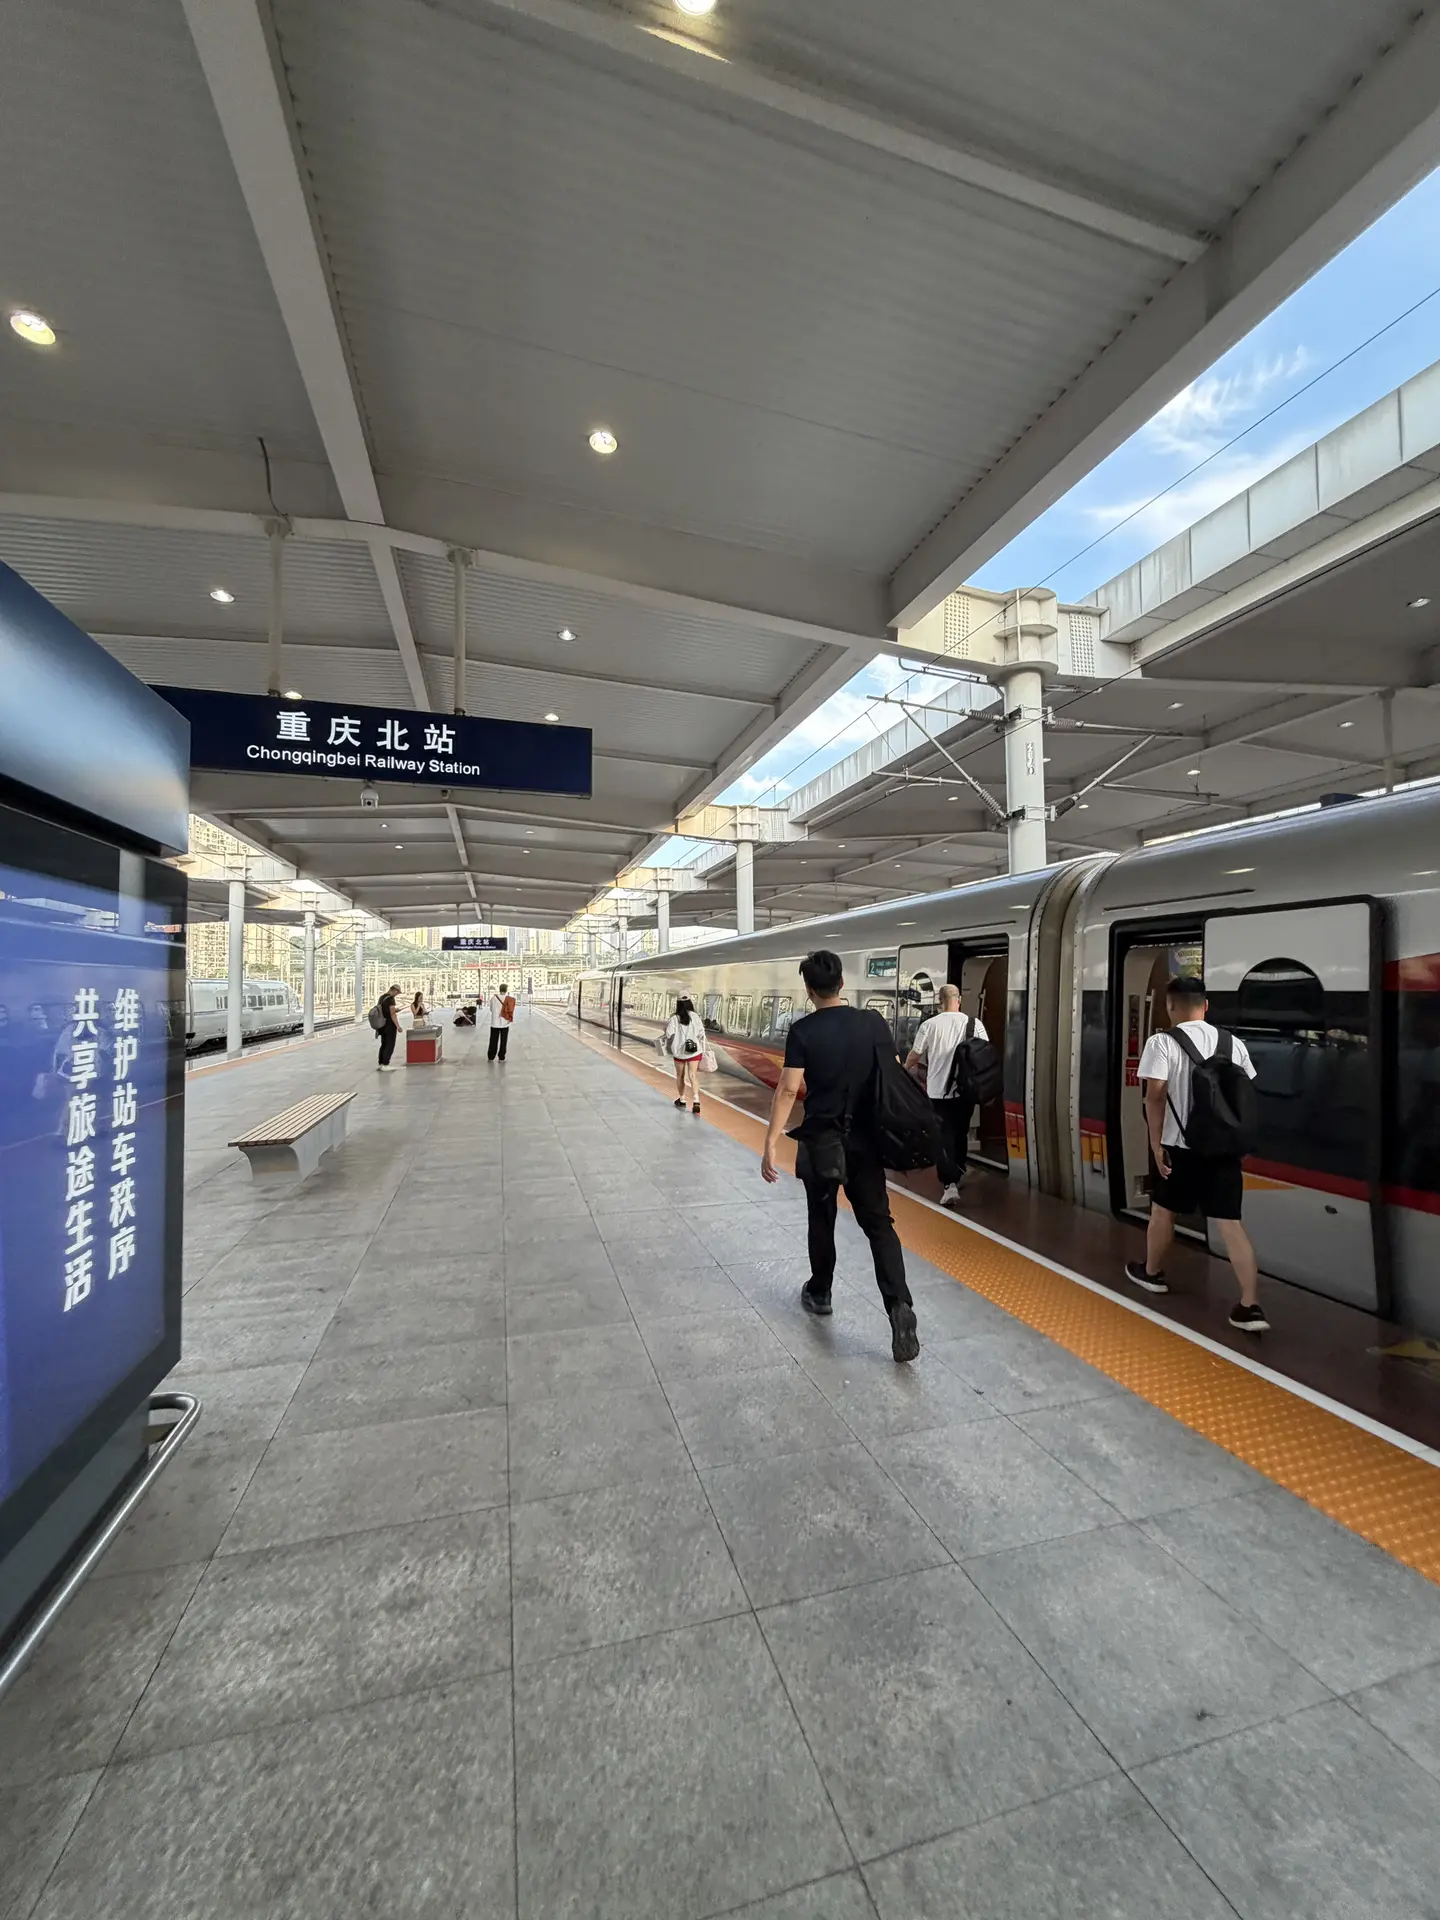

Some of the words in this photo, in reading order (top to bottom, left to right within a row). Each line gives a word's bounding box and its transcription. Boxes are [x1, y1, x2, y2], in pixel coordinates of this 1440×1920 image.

[246, 744, 361, 768] Chongqingbei
[364, 754, 425, 774] Railway
[428, 762, 480, 776] Station
[275, 710, 456, 754] 重庆北站
[62, 988, 100, 1314] 共享旅途生活
[107, 988, 140, 1281] 维护站车秩序
